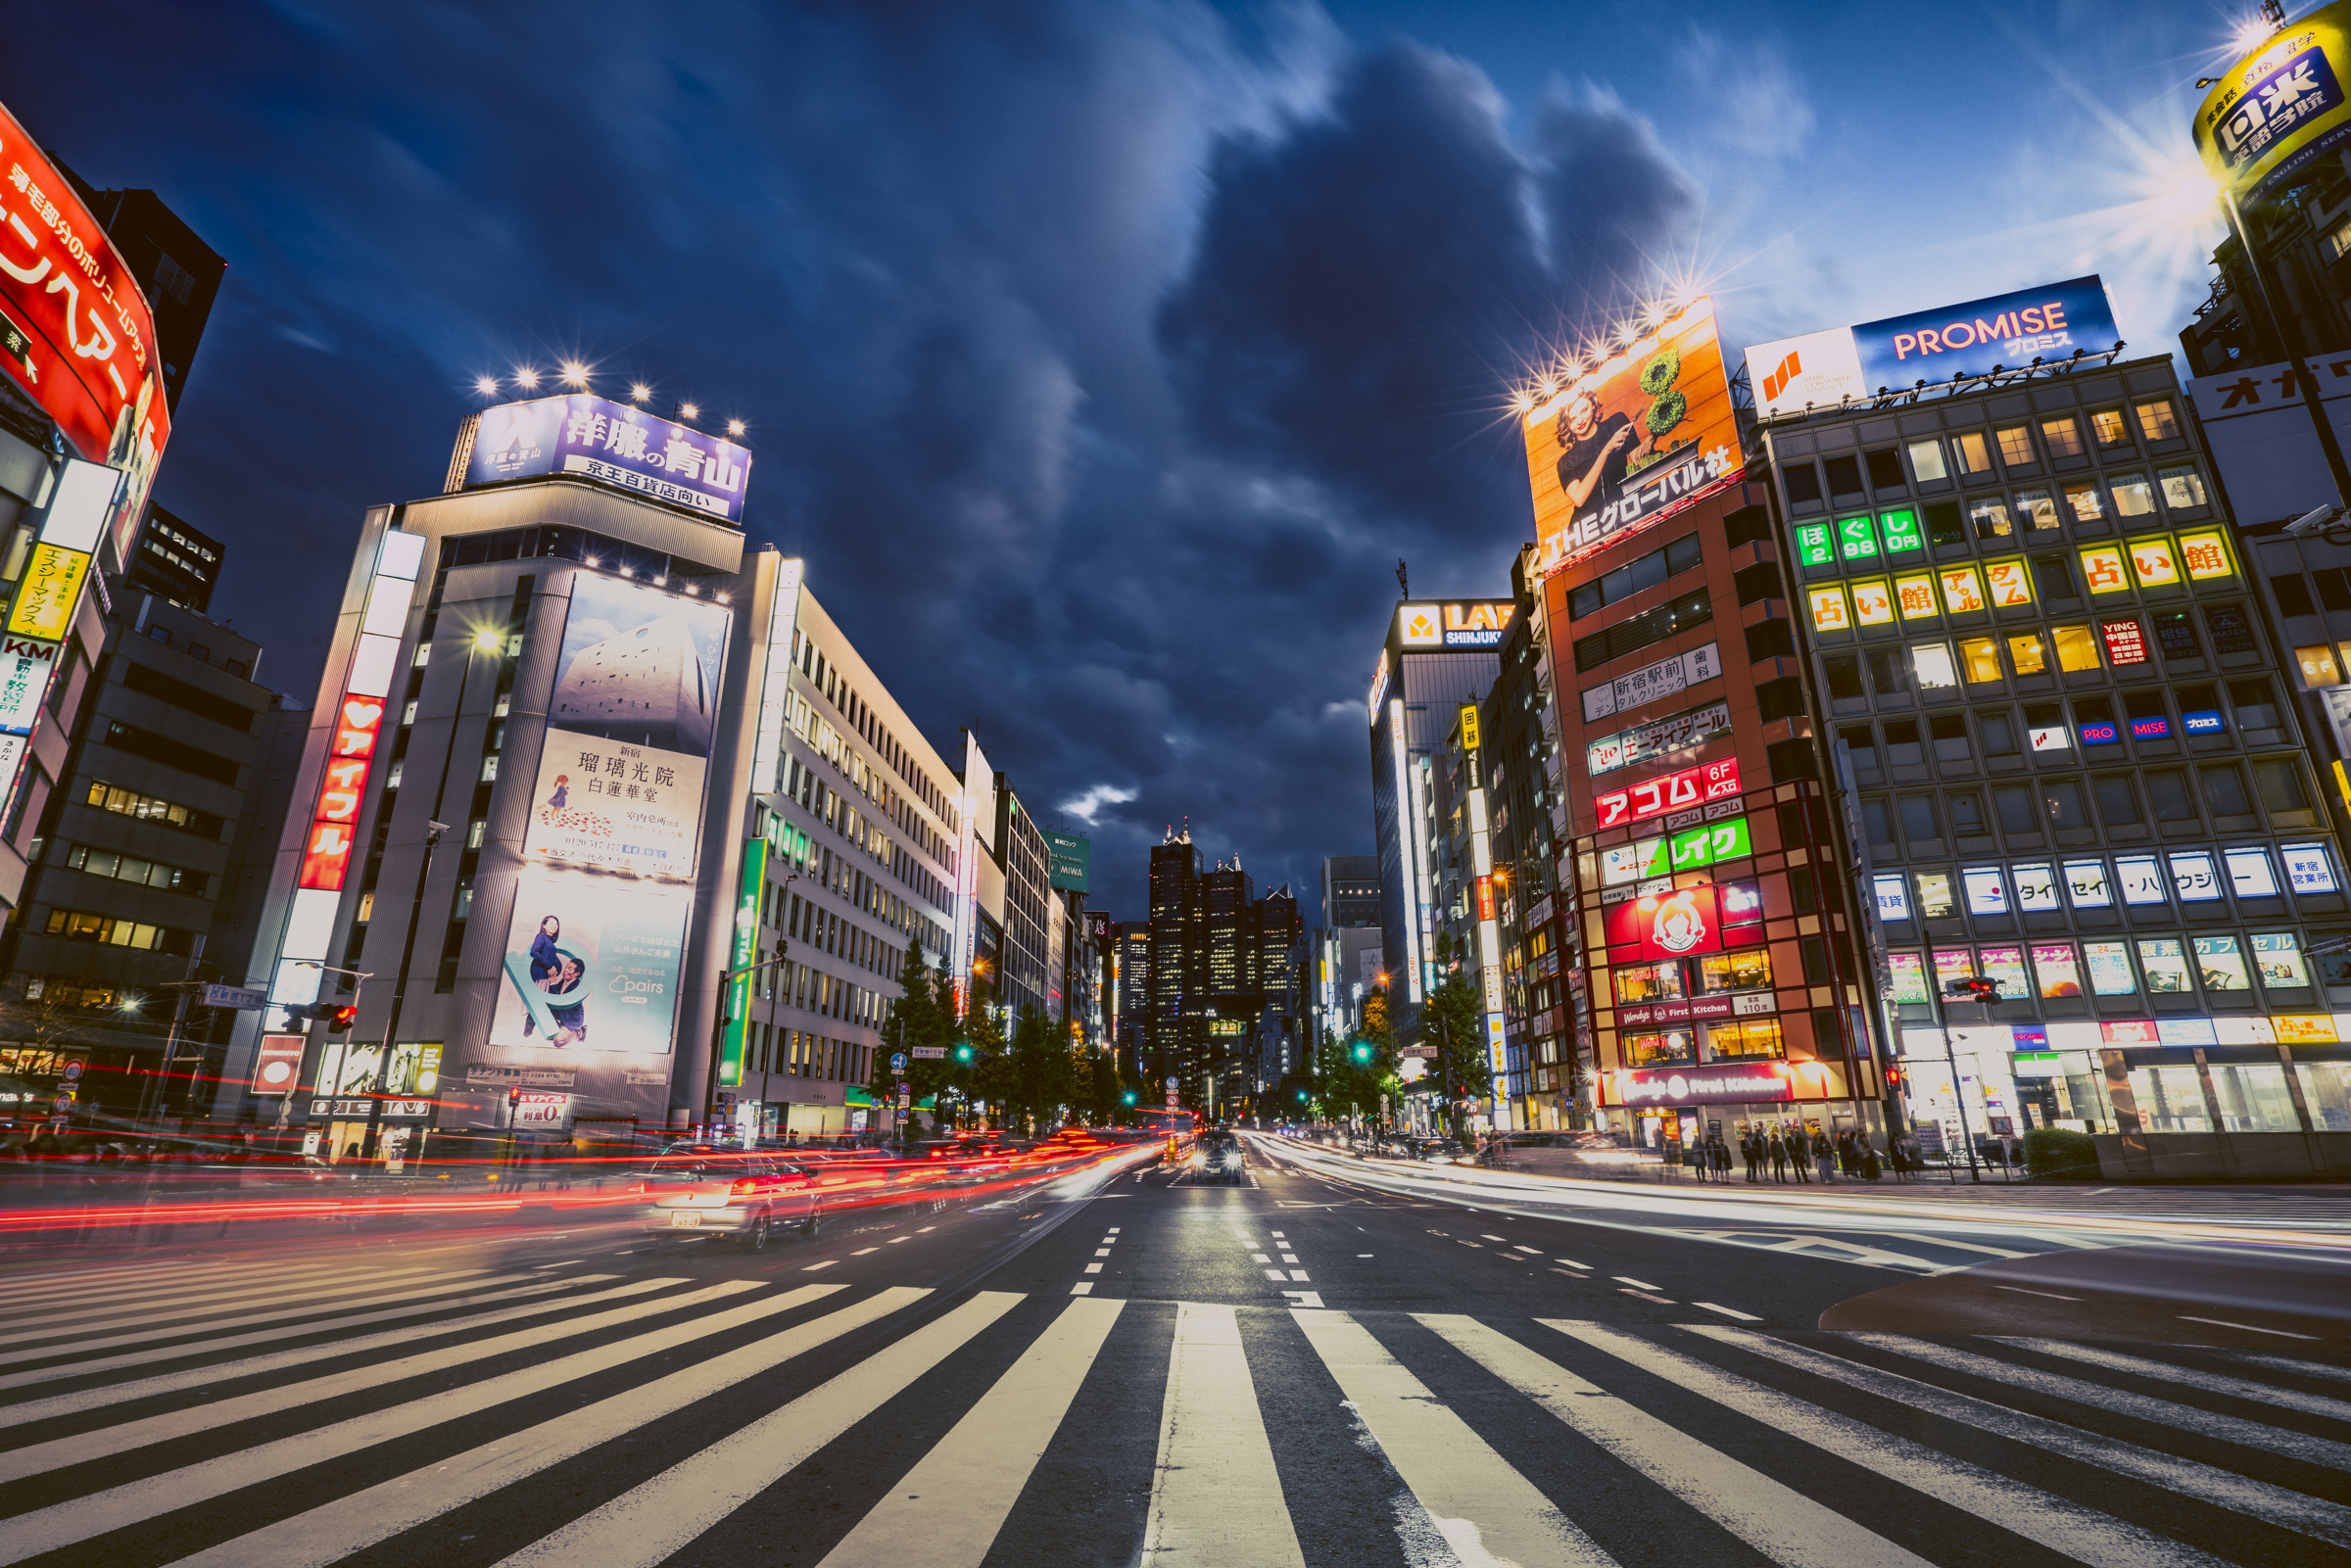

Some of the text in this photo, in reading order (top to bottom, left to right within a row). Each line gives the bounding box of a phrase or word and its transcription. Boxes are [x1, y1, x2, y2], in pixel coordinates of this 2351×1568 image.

[2267, 148, 2315, 186] ENGLISH
[1893, 302, 2068, 360] PROMISE
[2004, 331, 2074, 356] プロミス
[565, 410, 742, 493] 洋服の青山
[585, 459, 711, 507] 京王百貨店向い
[1545, 445, 1732, 560] THEグローバル社
[1801, 514, 1908, 546] ほぐし
[1812, 534, 1919, 563] 2,980円
[2087, 543, 2223, 588] 占い館
[20, 548, 63, 626] エスシーマックス
[1815, 585, 1933, 625] 占い館
[2103, 621, 2138, 633] YING
[2160, 627, 2191, 640] 相続
[3, 638, 55, 662] KM
[2177, 648, 2199, 658] 0120
[1694, 649, 1711, 679] 歯科
[1615, 661, 1681, 696] 新宿駅前
[1595, 676, 1685, 718] デンタルクリニック
[1624, 714, 1726, 758] エーアイアール
[2083, 717, 2220, 740] PRO MISE プロミス
[619, 745, 642, 759] 新宿
[578, 751, 675, 787] 瑠璃光院
[1709, 762, 1730, 781] 6F
[313, 731, 372, 855] アイフル
[588, 777, 658, 805] 白蓮華堂
[1721, 783, 1738, 794] 入口
[1602, 777, 1697, 824] アコム
[1708, 800, 1740, 818] アコム
[1669, 810, 1700, 828] アコム
[1670, 827, 1737, 865] レイク
[1061, 866, 1083, 878] MIWA
[2292, 872, 2329, 884] 営業所
[2294, 861, 2320, 873] 新宿
[2020, 873, 2252, 900] タイセイ・ハウジー
[2097, 945, 2110, 954] 24
[2139, 935, 2293, 958] 酸素カプセル
[209, 989, 264, 1004] 西新宿1丁目
[625, 979, 664, 994] pairs
[1623, 1004, 1727, 1024] Wendy's First Kitchen
[1743, 1003, 1768, 1013] 110席
[66, 1066, 79, 1077] 40
[470, 1068, 521, 1077] テナント募集
[1688, 1079, 1724, 1094] First
[1726, 1077, 1787, 1093] Kitchen
[538, 1094, 565, 1103] アイフル
